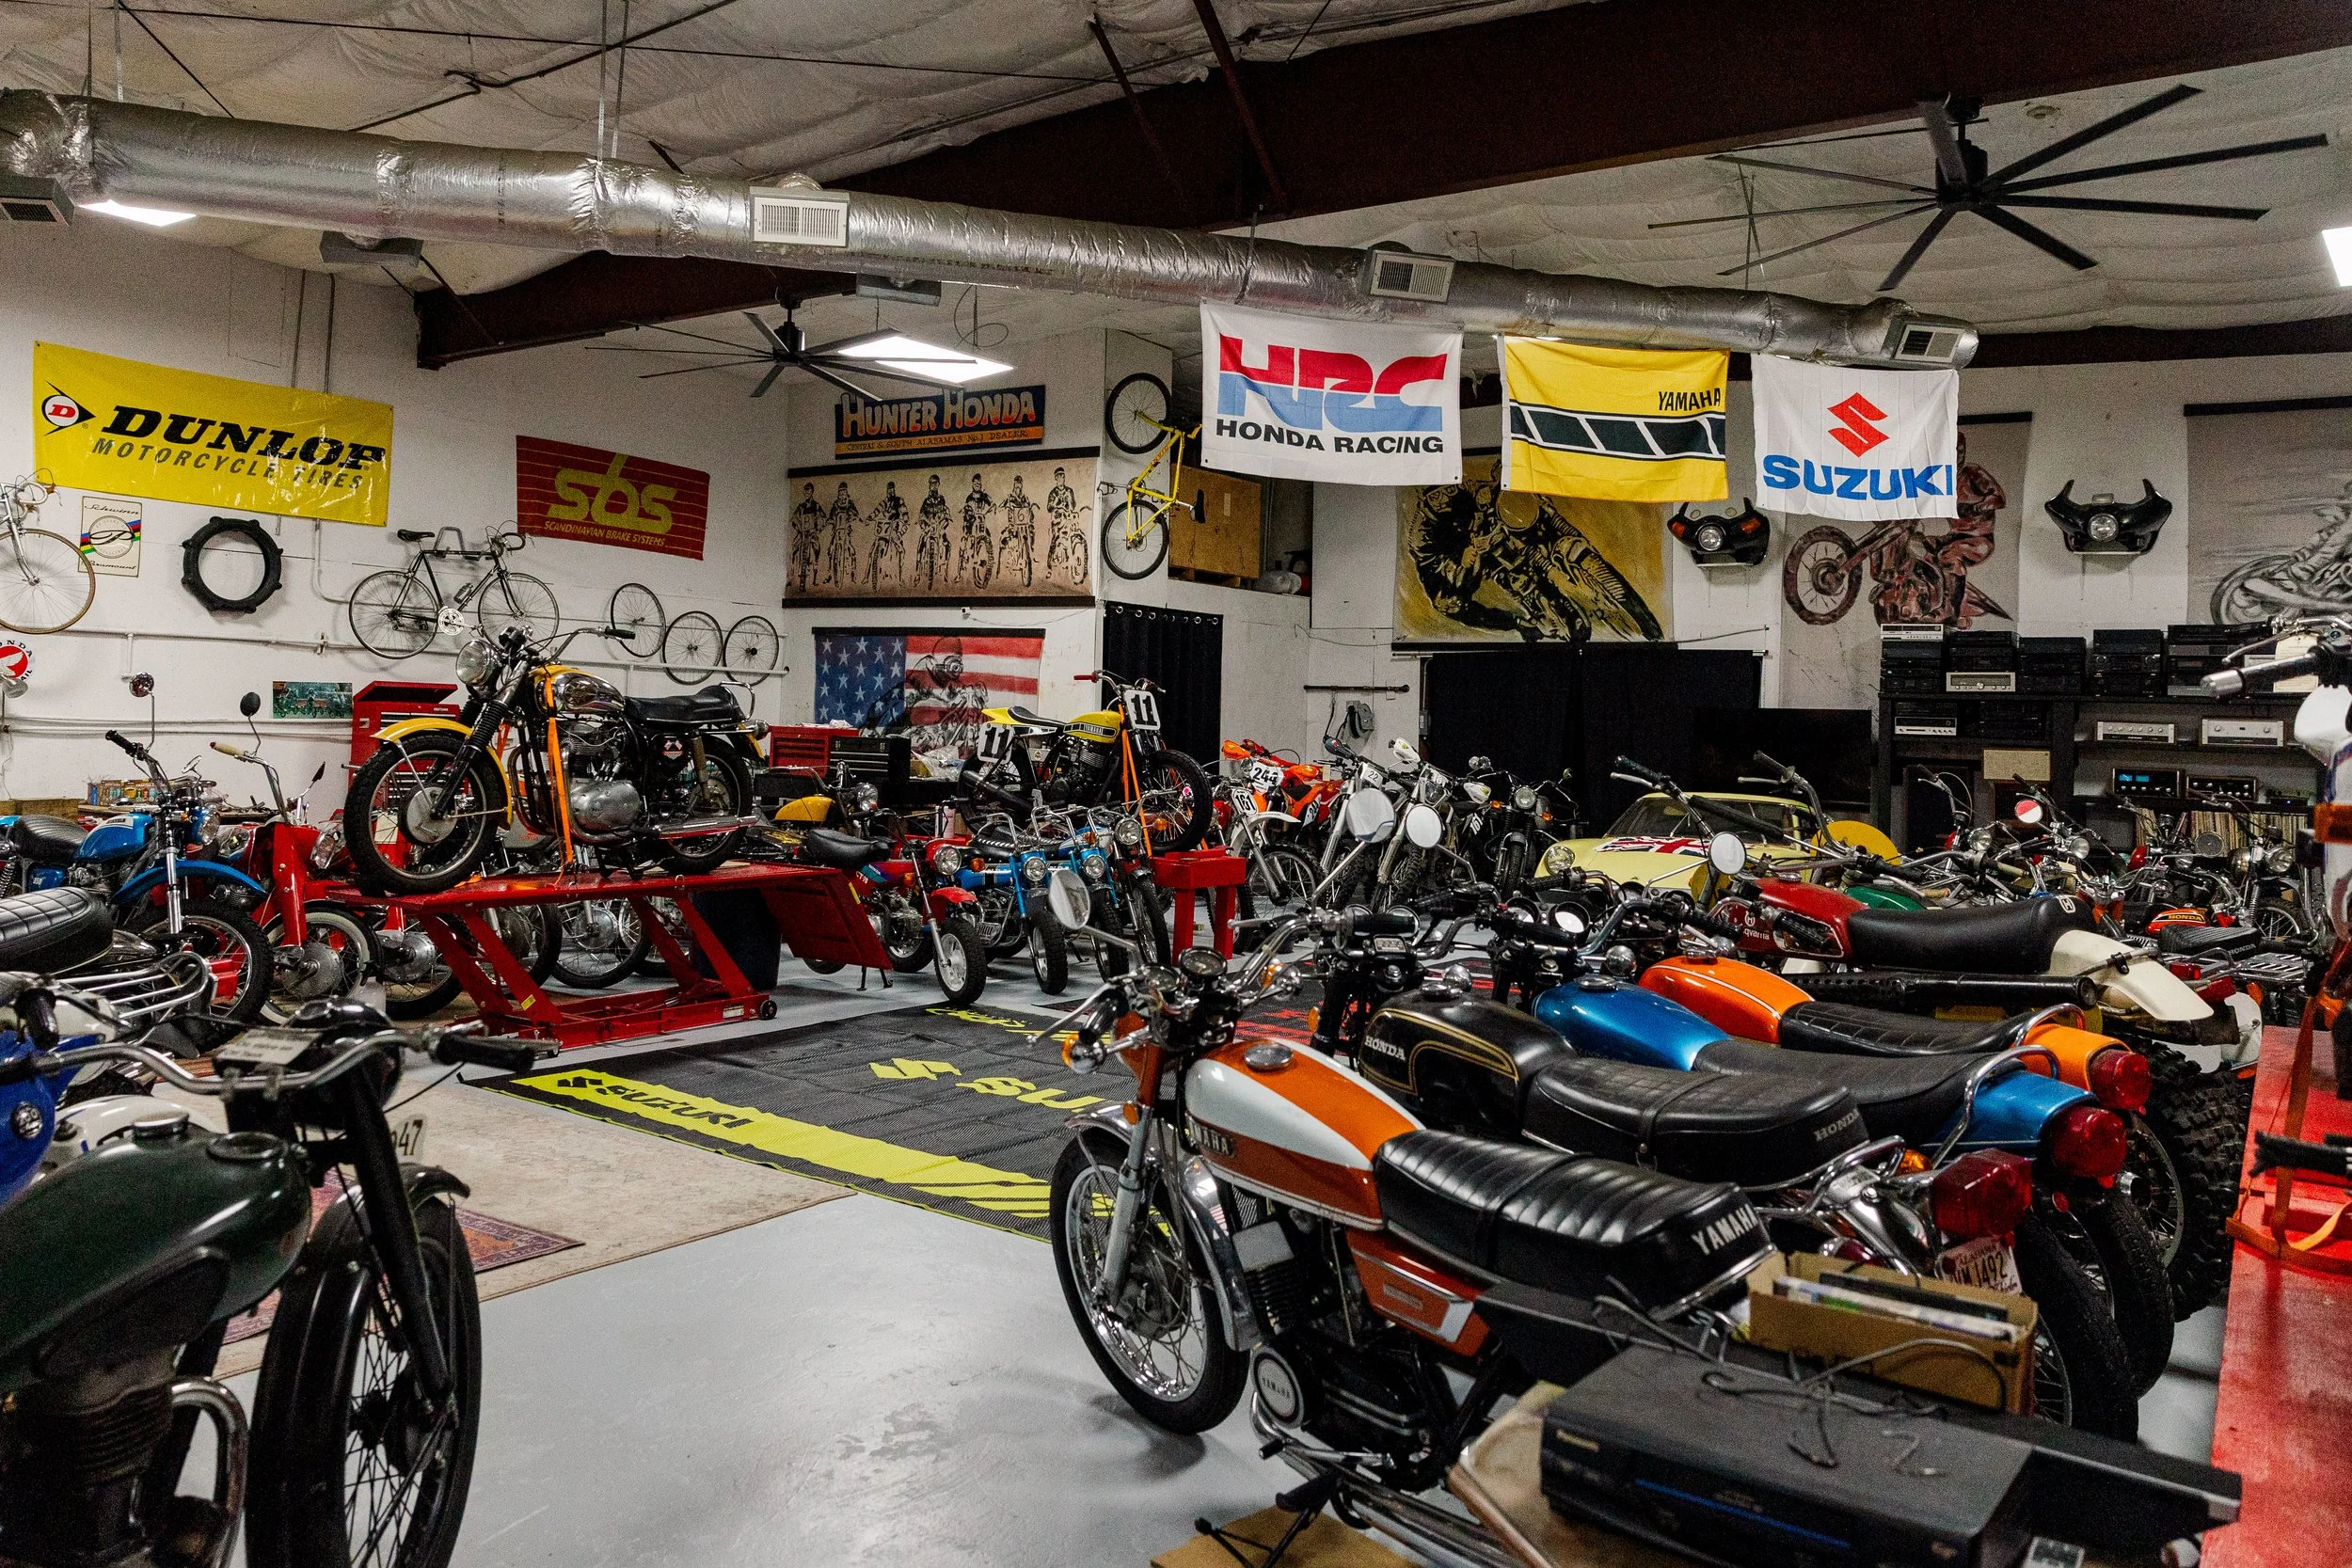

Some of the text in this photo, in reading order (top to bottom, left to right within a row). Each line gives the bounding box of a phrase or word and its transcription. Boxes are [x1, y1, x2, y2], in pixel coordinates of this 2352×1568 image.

[841, 388, 1035, 437] HUNTER HONDA
[1658, 388, 1721, 411] YAMAHA
[102, 405, 386, 469] DUNLOP
[990, 430, 1028, 440] DEALER
[1216, 419, 1443, 453] HONDA RACING
[92, 437, 363, 490] MOTORCYCLE TIRES
[1763, 454, 1953, 500] SUZUKI
[85, 504, 138, 515] Schwinn
[545, 520, 666, 546] SCANDINAVIAN BRAKE SYSTEMS
[1131, 693, 1157, 726] 11
[981, 724, 1013, 758] 11
[1368, 770, 1379, 783] 22
[1470, 813, 1484, 835] 161
[2228, 943, 2256, 956] HONDA
[1365, 1036, 1406, 1061] HONDA
[595, 1085, 755, 1129] SUZUKI
